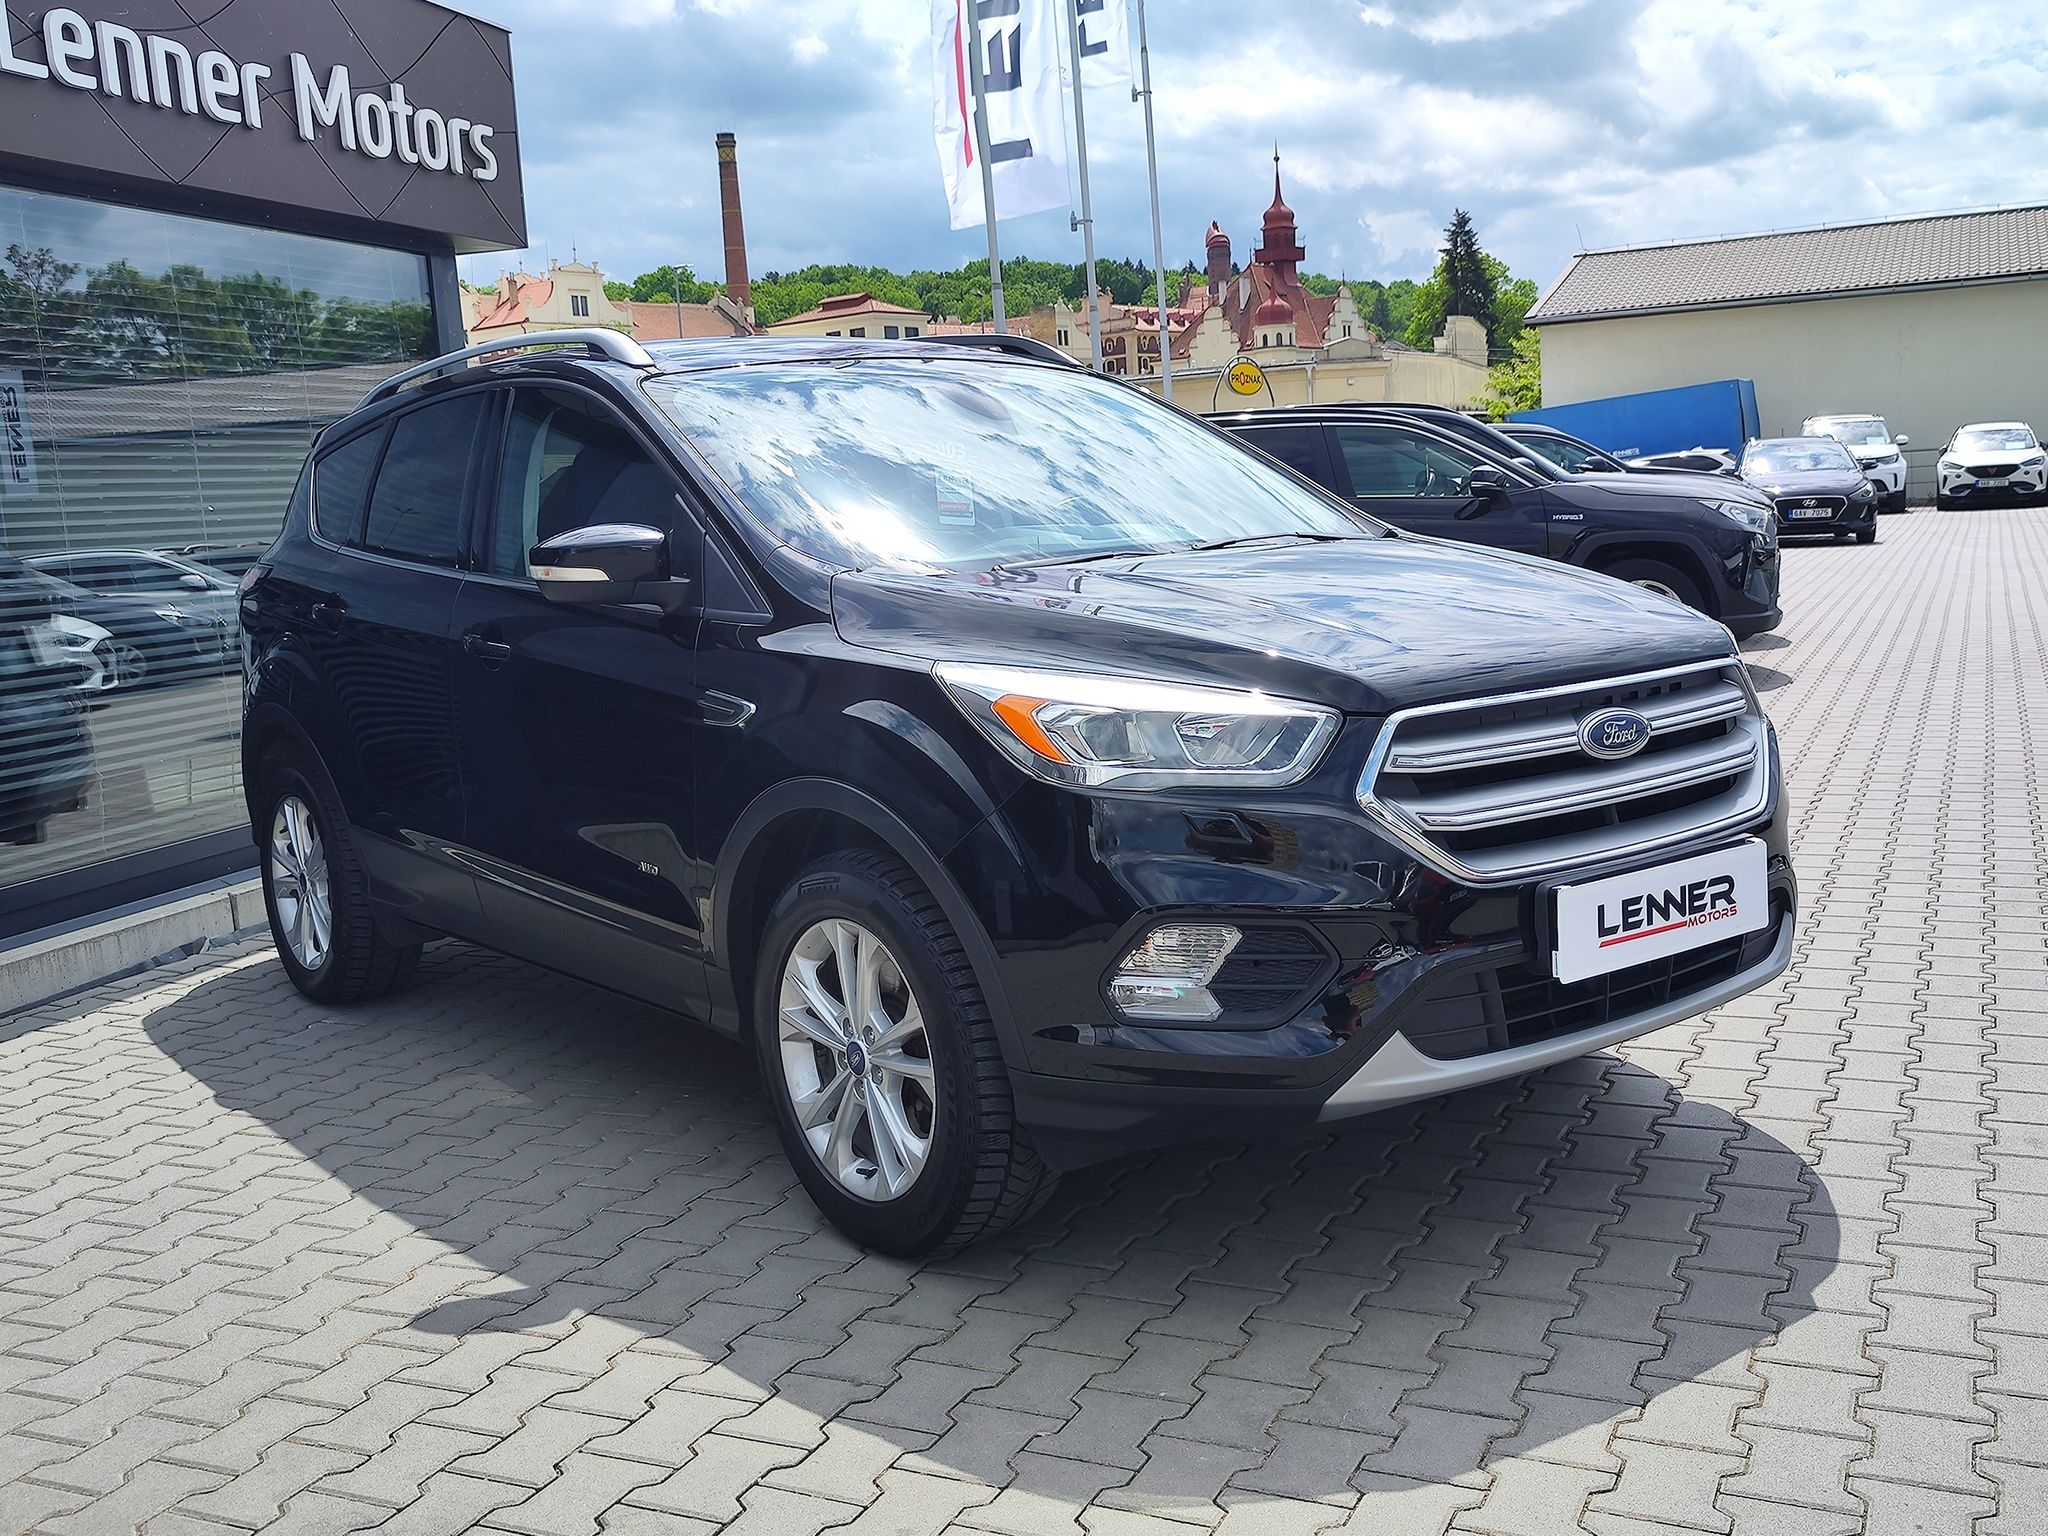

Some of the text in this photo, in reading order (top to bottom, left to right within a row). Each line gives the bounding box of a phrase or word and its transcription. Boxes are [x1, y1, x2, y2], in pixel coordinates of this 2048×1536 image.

[0, 0, 498, 182] Lenner Motors
[1603, 720, 1638, 746] Ford
[1597, 874, 1737, 939] LENNER
[1687, 905, 1738, 928] MOTORS
